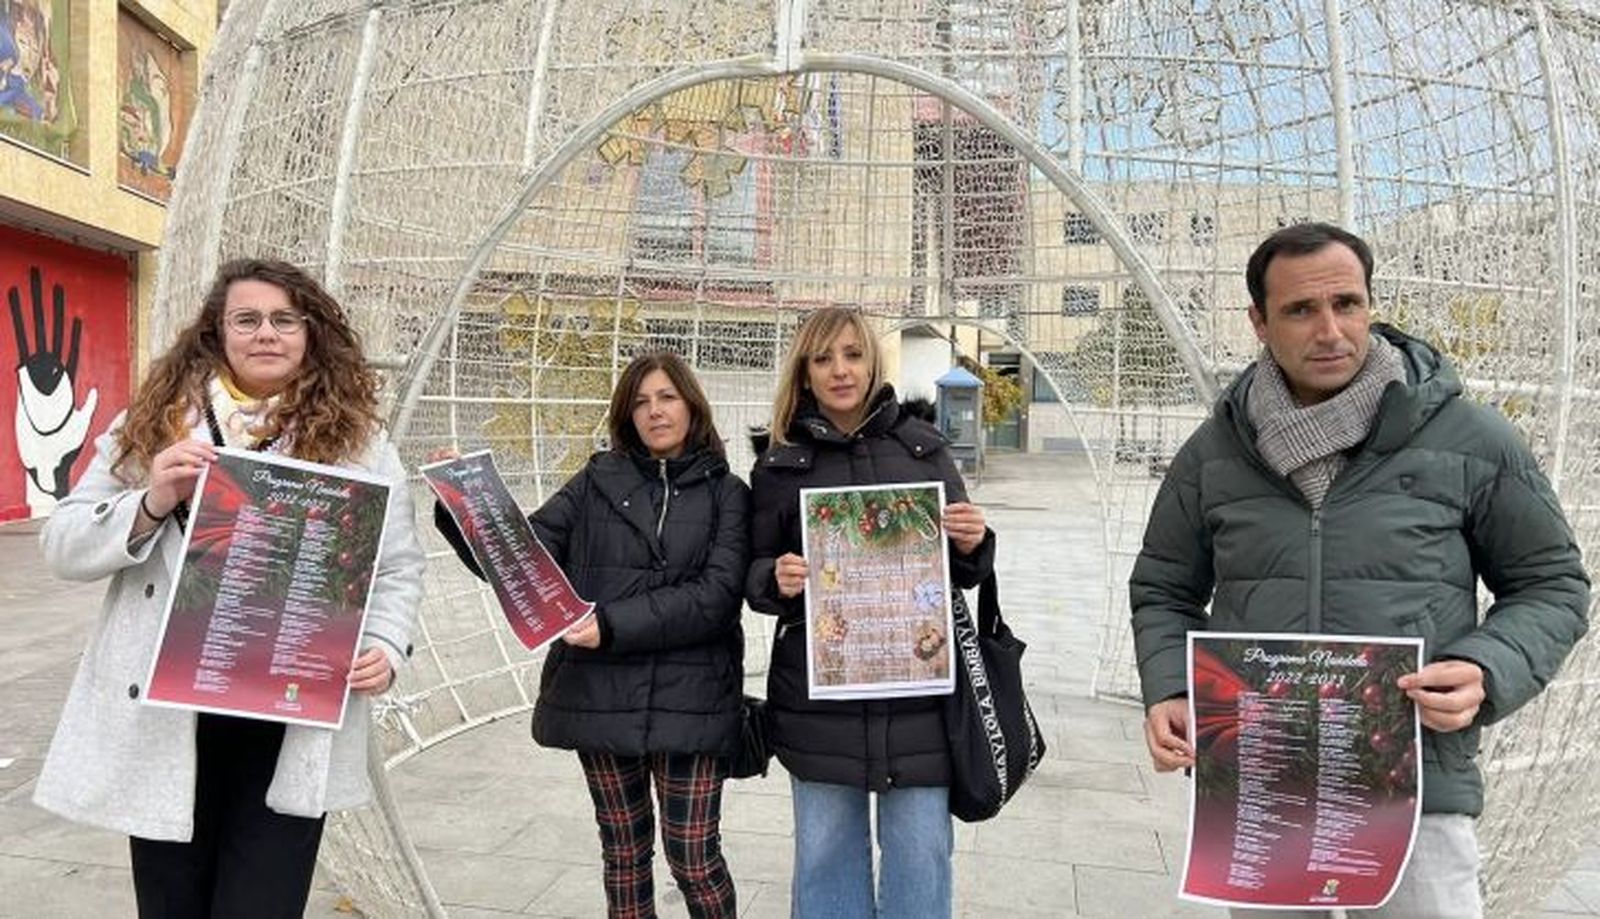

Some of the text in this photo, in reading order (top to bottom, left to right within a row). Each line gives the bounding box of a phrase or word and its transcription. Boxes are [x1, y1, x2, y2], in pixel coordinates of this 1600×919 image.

[963, 636, 987, 688] BIMBA
[1243, 648, 1307, 669] Programa
[980, 693, 1004, 741] LOLA
